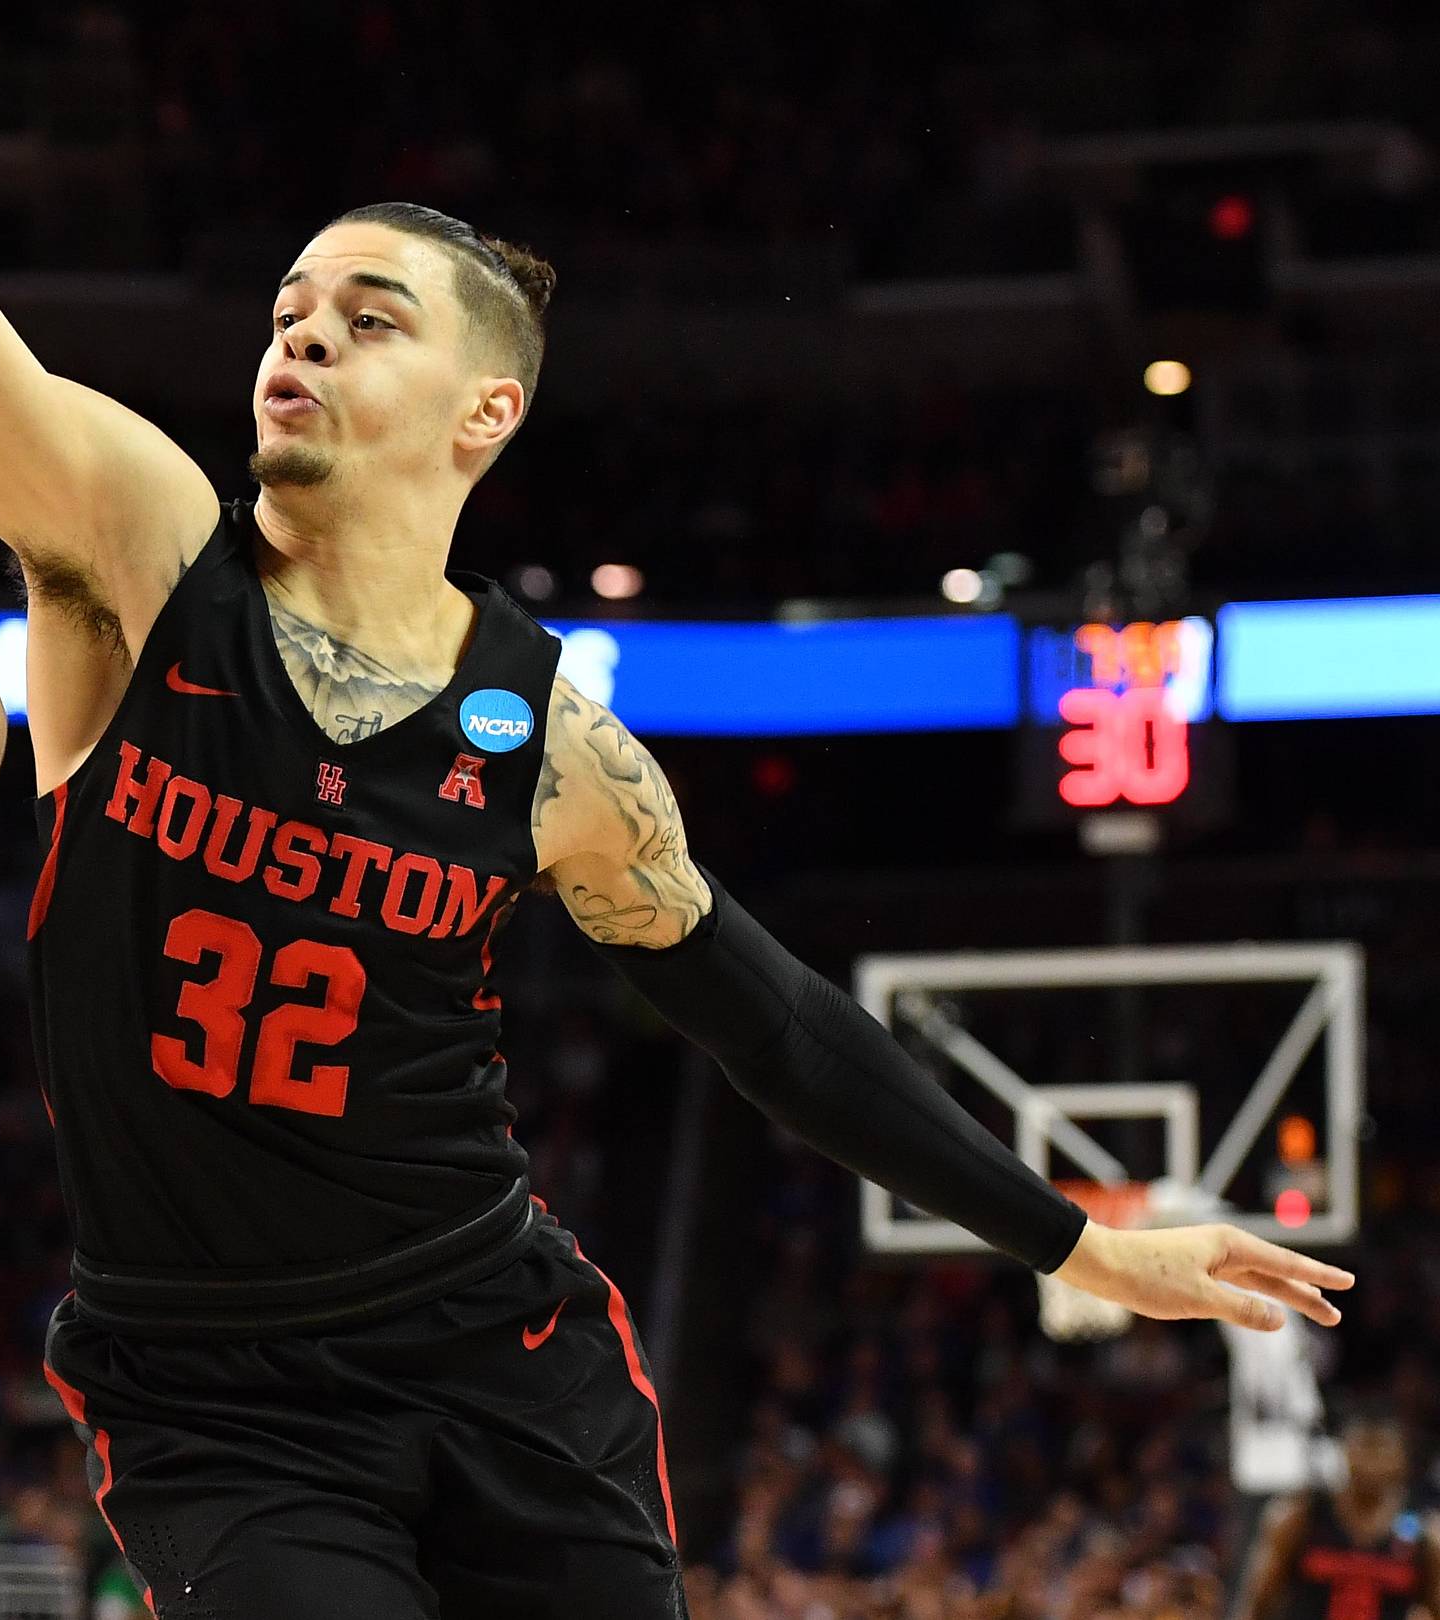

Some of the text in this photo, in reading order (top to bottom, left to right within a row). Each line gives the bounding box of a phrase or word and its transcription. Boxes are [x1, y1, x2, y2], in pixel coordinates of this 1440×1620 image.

[467, 714, 529, 737] NCAA
[103, 739, 509, 940] HOUSTON
[150, 907, 367, 1118] 32
